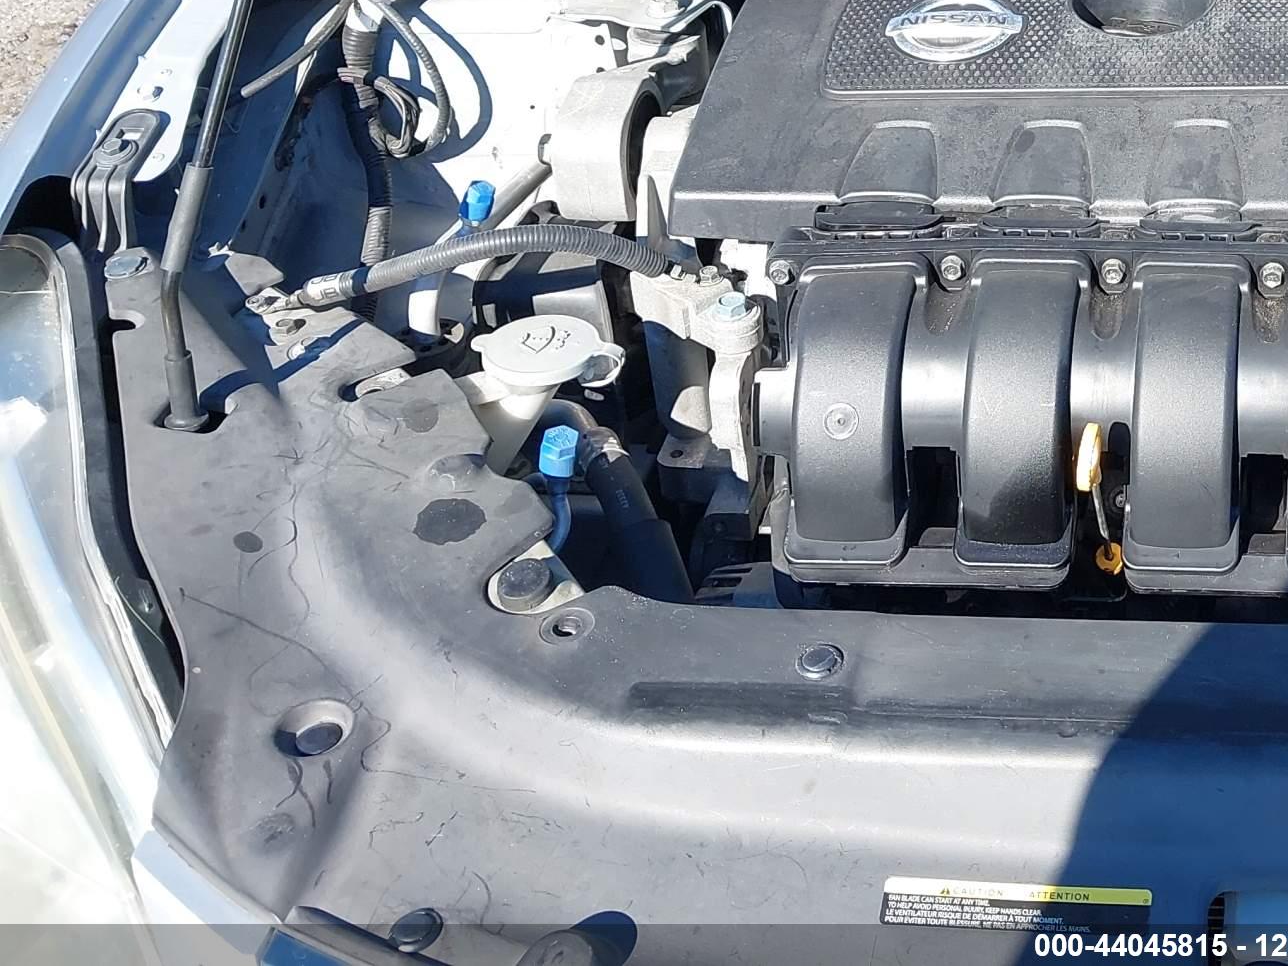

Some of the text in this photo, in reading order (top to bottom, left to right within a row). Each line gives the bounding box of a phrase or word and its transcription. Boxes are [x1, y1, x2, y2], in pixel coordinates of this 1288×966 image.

[900, 14, 1007, 27] NISSAN
[953, 887, 1090, 901] CAUTION ATTENTION
[894, 909, 937, 918] VENTILATEUR
[937, 911, 962, 919] RISQUE
[932, 904, 963, 912] PERSONAL
[1000, 908, 1021, 916] HANDS
[982, 921, 993, 929] NE
[1015, 923, 1056, 931] APPROCHER
[1056, 924, 1067, 932] LES
